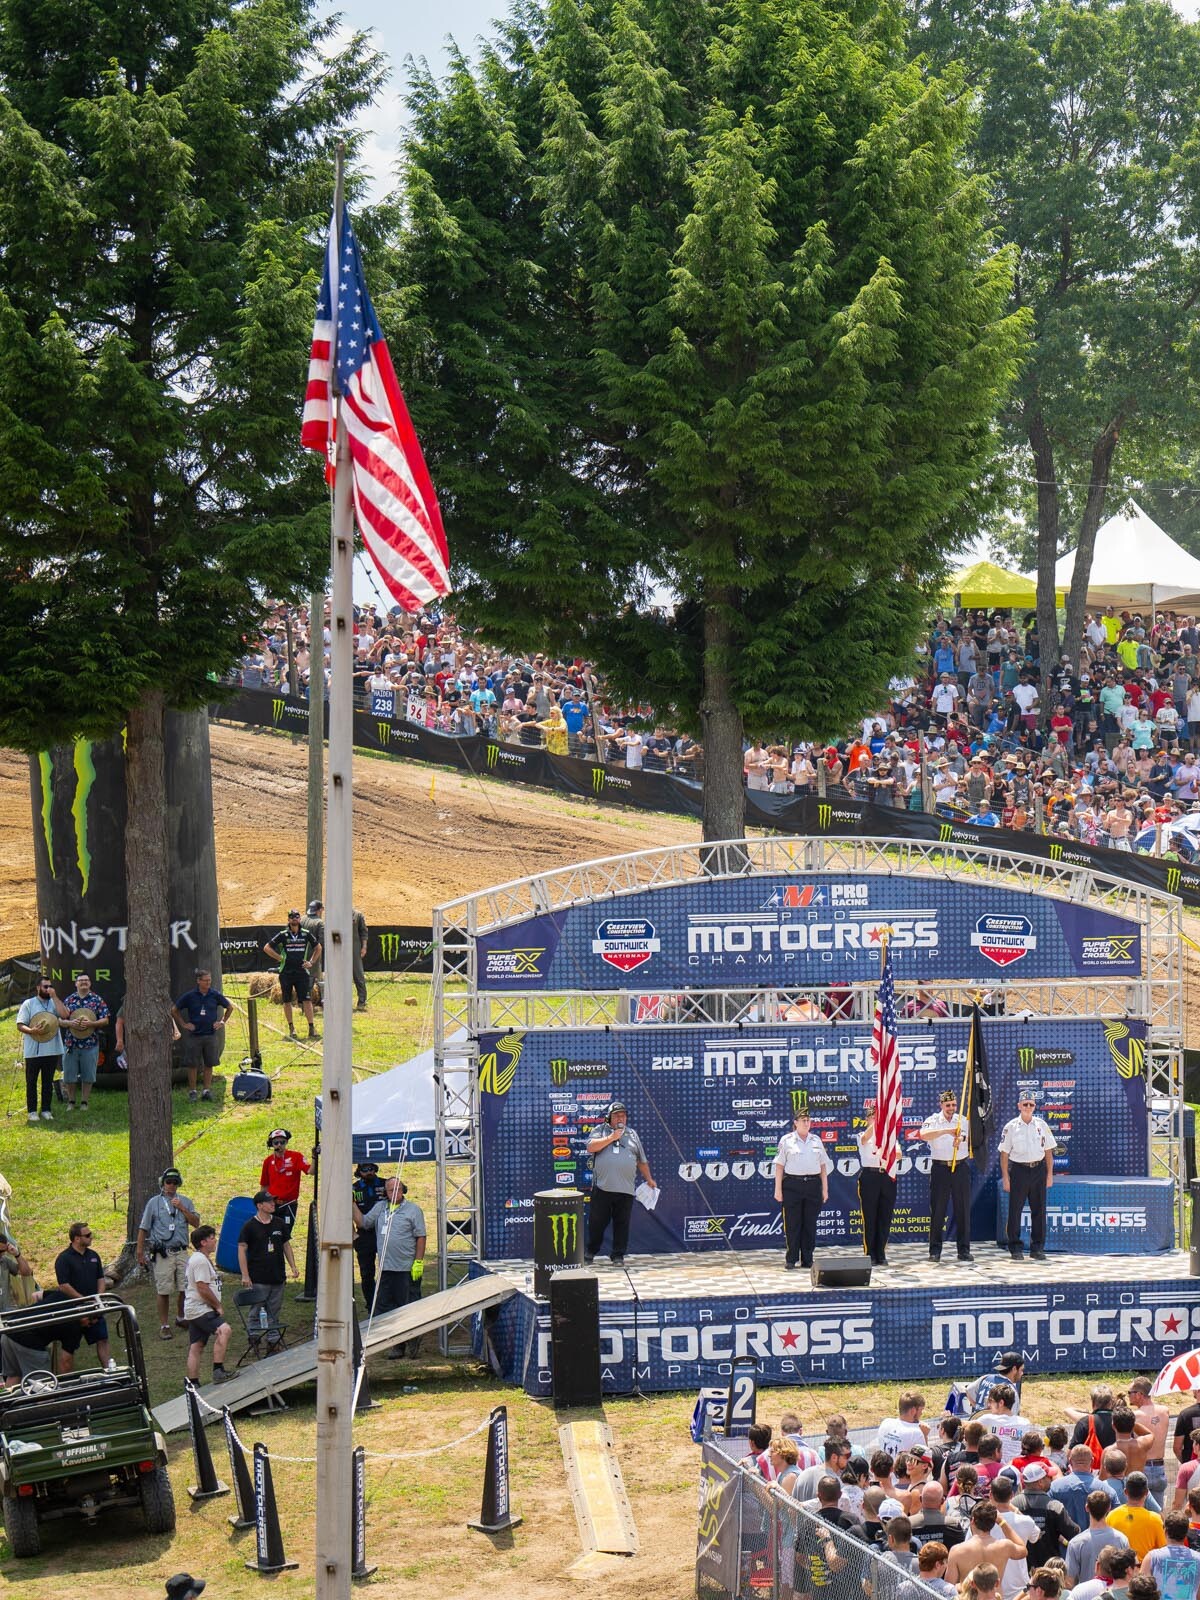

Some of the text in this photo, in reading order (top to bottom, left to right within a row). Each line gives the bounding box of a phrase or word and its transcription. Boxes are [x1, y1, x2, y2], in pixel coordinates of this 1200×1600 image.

[375, 699, 392, 711] 238
[411, 704, 422, 719] 96
[760, 884, 868, 908] AMA PRO
[831, 898, 869, 907] RACING
[781, 910, 846, 922] PRO
[688, 921, 939, 953] MOTOCROSS
[982, 935, 1025, 946] SOUTHWICK
[604, 942, 649, 951] SOUTHWICK
[688, 949, 939, 965] CHAMPIONSHIP
[791, 1036, 850, 1047] PRO
[568, 1064, 608, 1072] MONSTER
[652, 1056, 693, 1070] 2023
[732, 1099, 772, 1108] GEICO
[808, 1095, 848, 1103] MONSTER
[711, 1120, 747, 1132] WPS
[728, 1211, 784, 1239] Finals
[1052, 1292, 1135, 1307] PRO
[664, 1307, 750, 1322] PRO
[732, 1376, 754, 1419] 2
[712, 1405, 724, 1419] 2
[66, 1444, 98, 1457] OFFICIAL
[62, 1452, 106, 1467] Kawasaki
[497, 1420, 506, 1516] MOTOCROSS
[255, 1459, 267, 1559] MOTOCROSS
